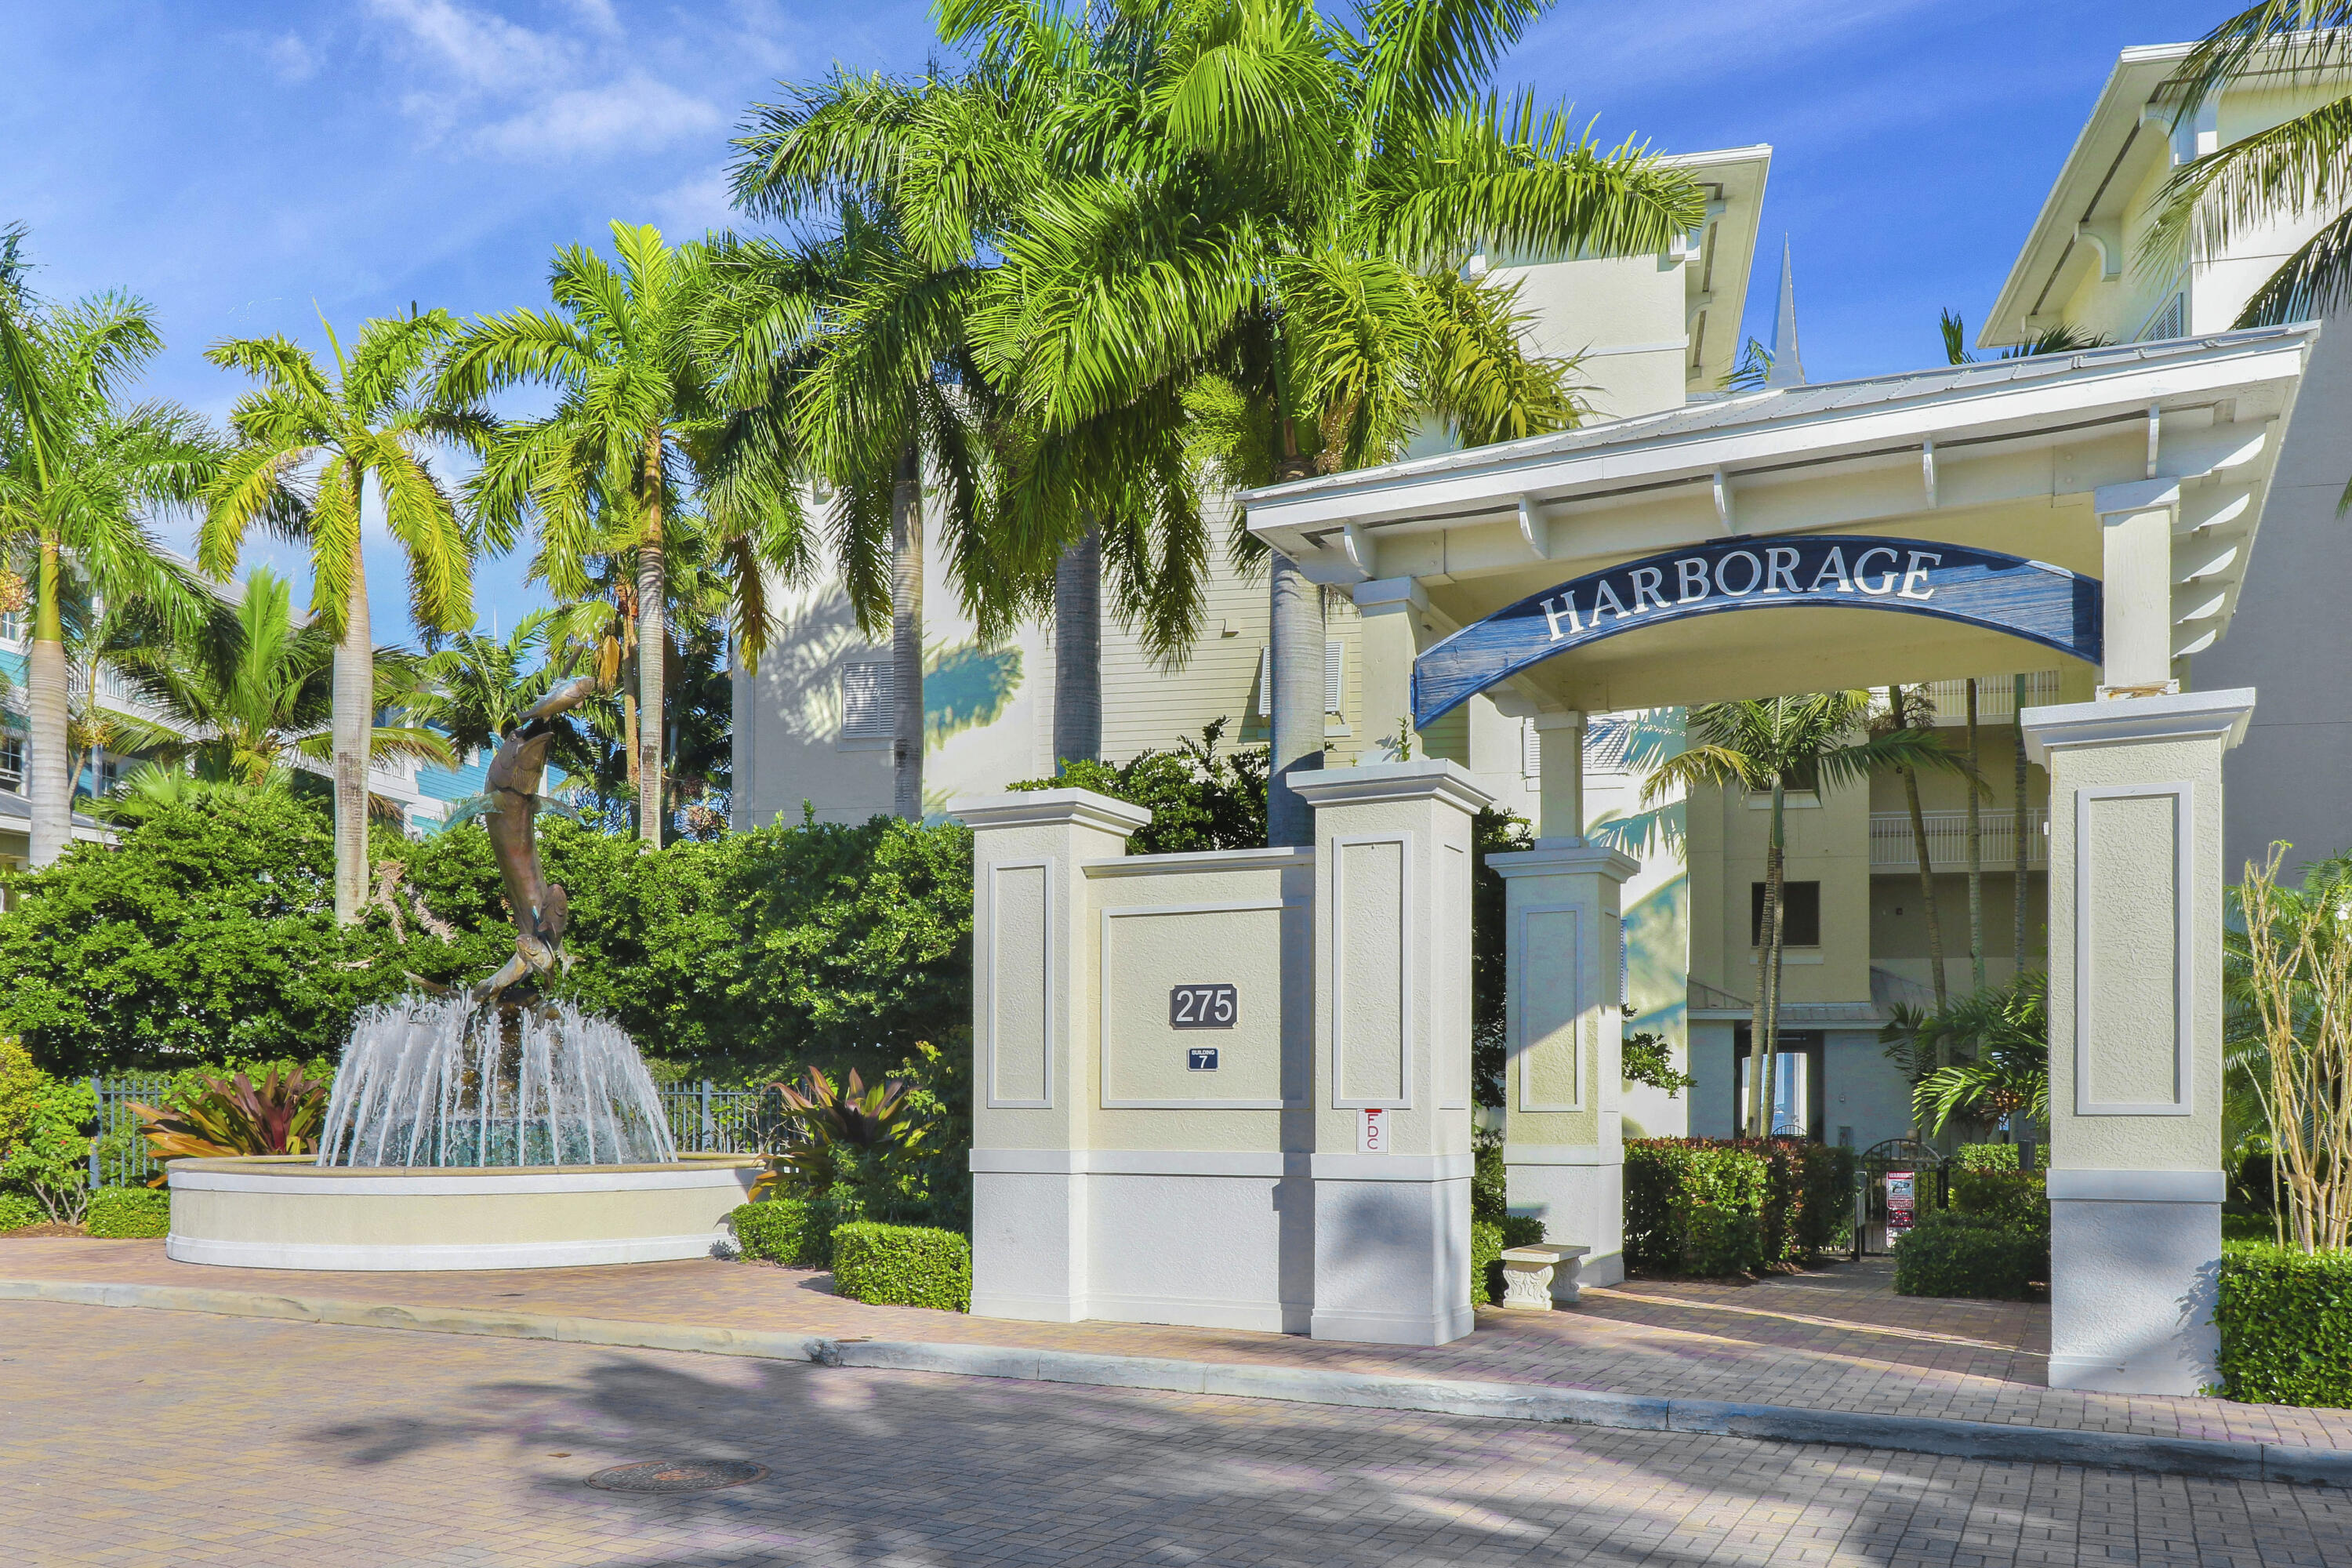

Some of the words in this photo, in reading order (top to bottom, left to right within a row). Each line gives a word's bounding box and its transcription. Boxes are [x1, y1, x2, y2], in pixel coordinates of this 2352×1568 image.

[1539, 546, 1942, 641] HARBORAGE
[1176, 989, 1232, 1022] 275
[1199, 1055, 1207, 1069] 7
[1367, 1113, 1379, 1150] FDC
